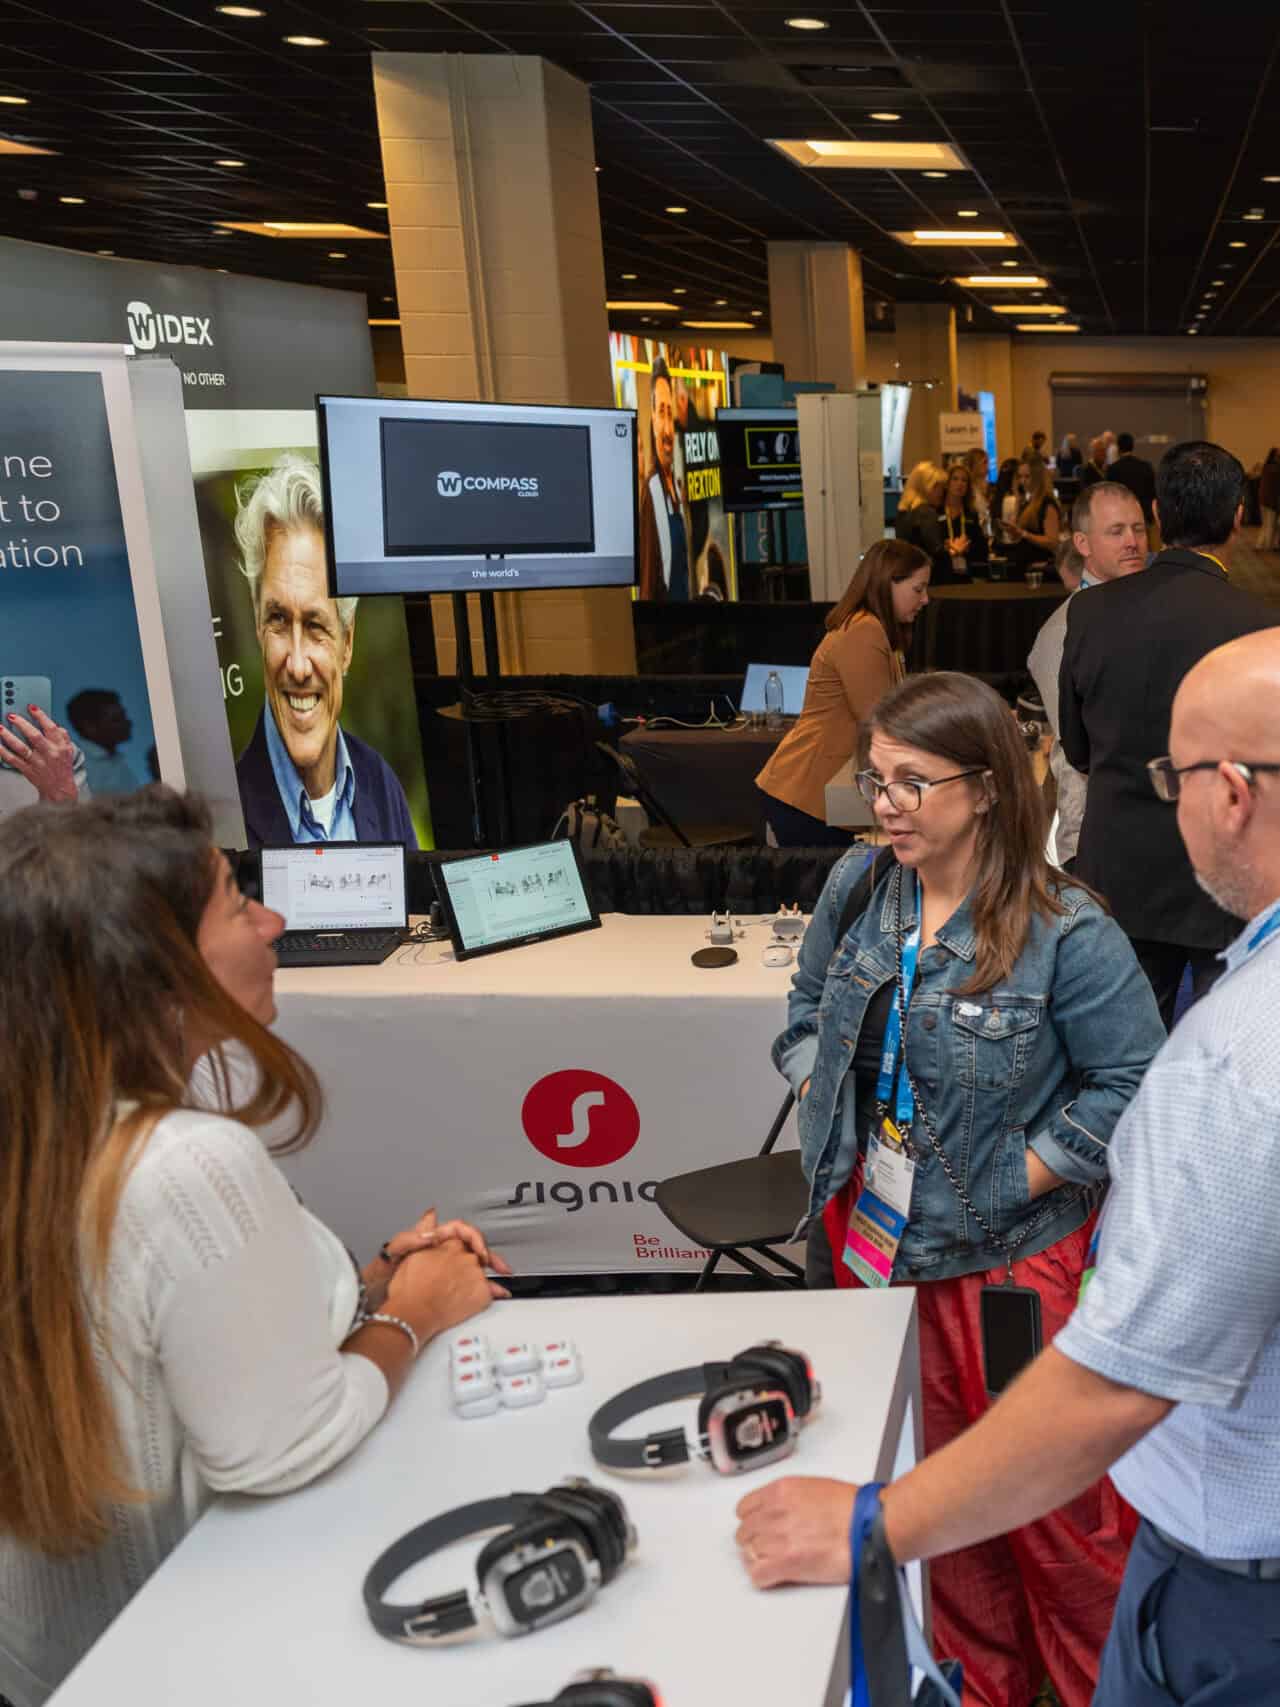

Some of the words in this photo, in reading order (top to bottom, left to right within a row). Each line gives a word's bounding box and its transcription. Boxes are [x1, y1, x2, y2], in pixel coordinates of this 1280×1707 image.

[127, 301, 214, 349] WIDEX
[183, 372, 197, 385] NO
[199, 373, 225, 386] OTHER
[684, 431, 706, 464] RELY
[463, 476, 539, 491] COMPASS
[687, 466, 720, 501] REXTON
[19, 494, 61, 522] to
[472, 569, 487, 578] the
[488, 568, 520, 579] world's
[633, 1234, 660, 1246] Be
